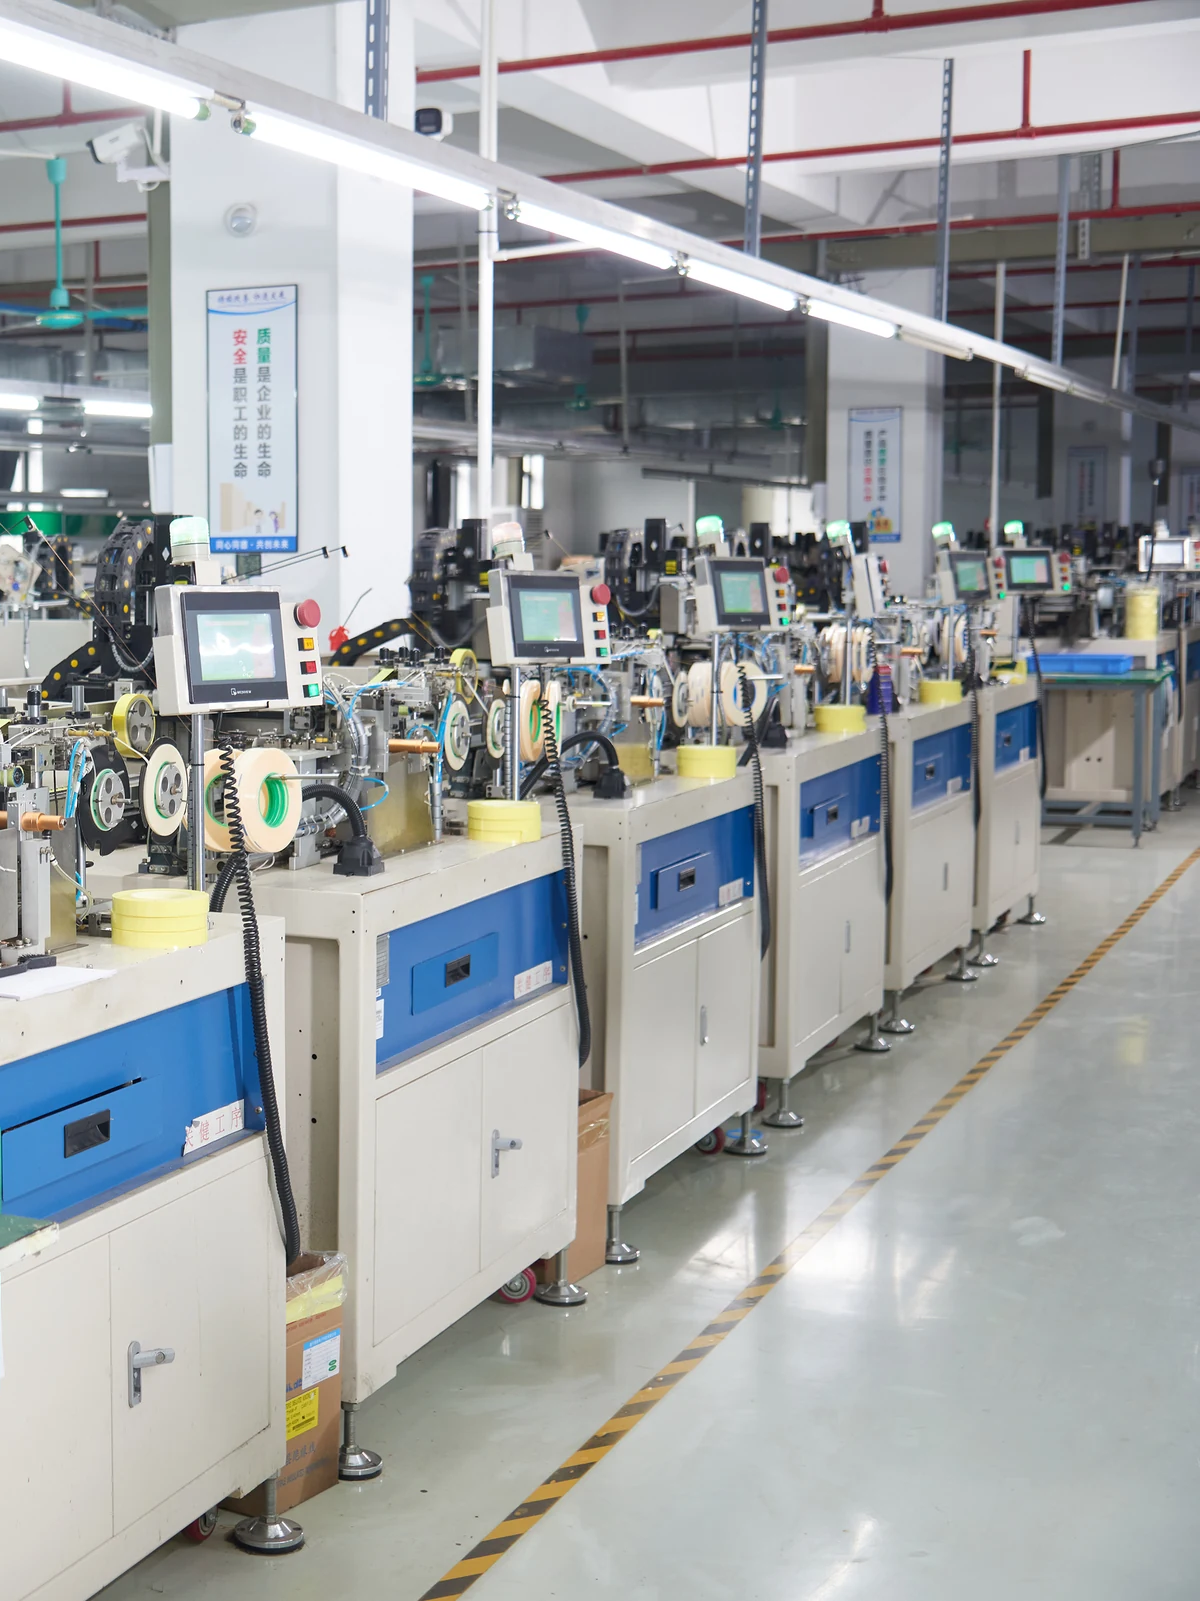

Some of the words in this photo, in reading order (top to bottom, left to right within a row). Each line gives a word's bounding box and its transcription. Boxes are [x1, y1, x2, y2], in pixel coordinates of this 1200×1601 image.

[232, 329, 247, 479] 安全是职工的生命
[256, 328, 271, 478] 质量是企业的生命
